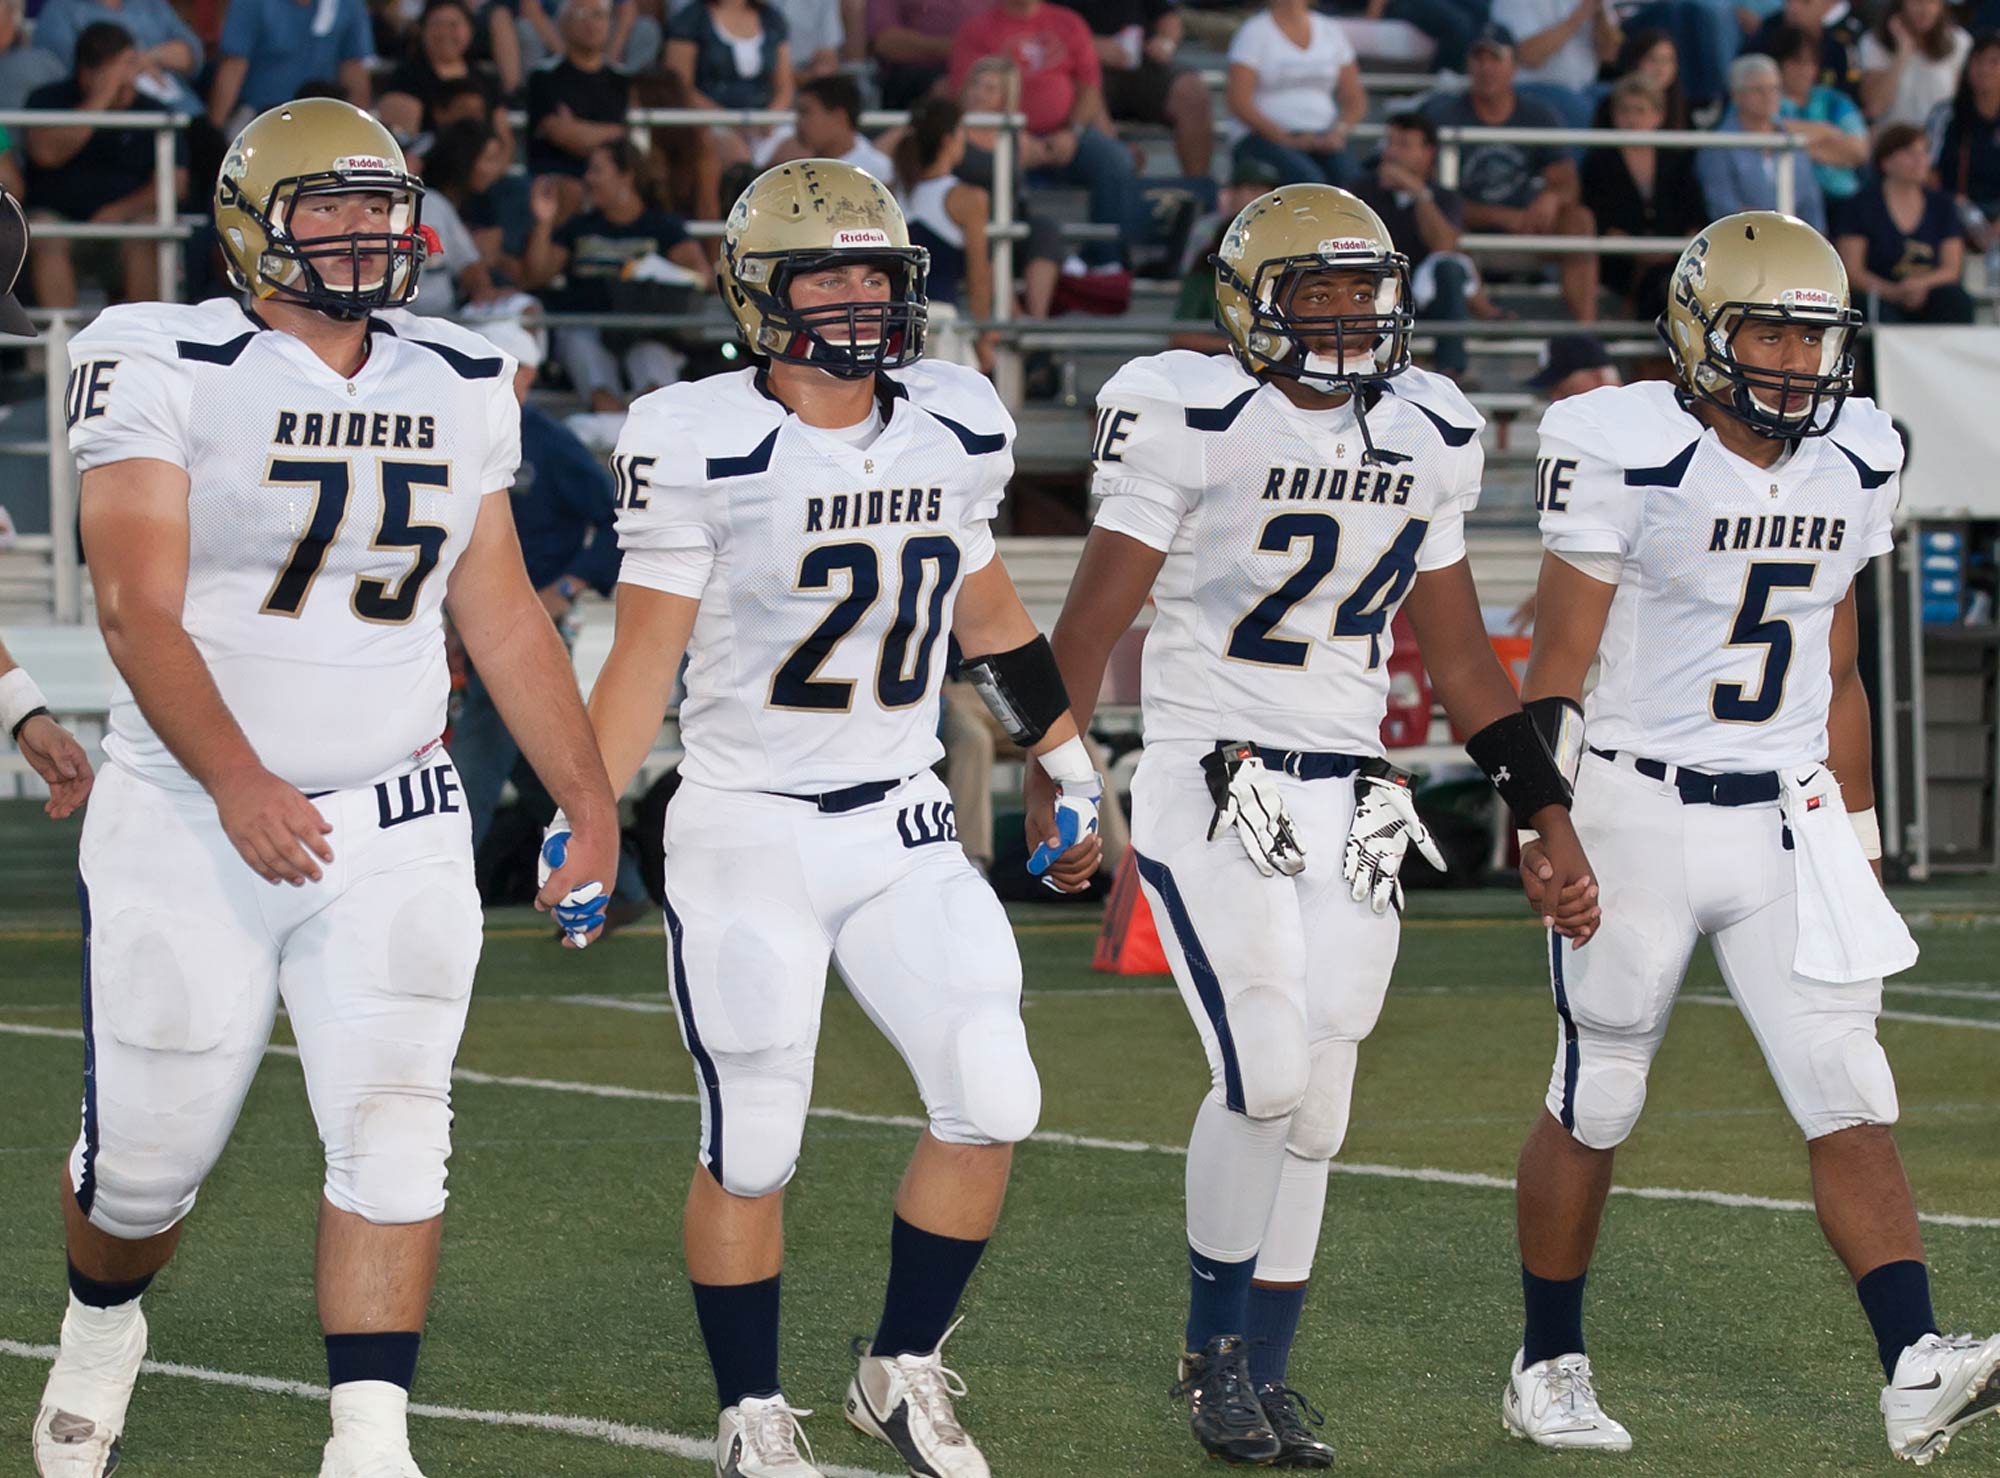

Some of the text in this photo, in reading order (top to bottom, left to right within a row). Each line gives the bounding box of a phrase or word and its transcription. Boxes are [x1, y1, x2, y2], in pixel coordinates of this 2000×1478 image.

[348, 158, 384, 169] Riddell
[840, 232, 884, 243] Riddell
[1332, 240, 1367, 250] Riddell
[1795, 290, 1828, 303] Riddell
[272, 408, 436, 450] RAIDERS
[1260, 466, 1416, 507] RAIDERS
[803, 486, 942, 534] RAIDERS
[258, 454, 453, 626] 75
[1707, 513, 1847, 552] RAIDERS
[1221, 508, 1432, 674] 24
[764, 531, 962, 714] 20
[1708, 558, 1821, 727] 5
[374, 763, 459, 830] WE
